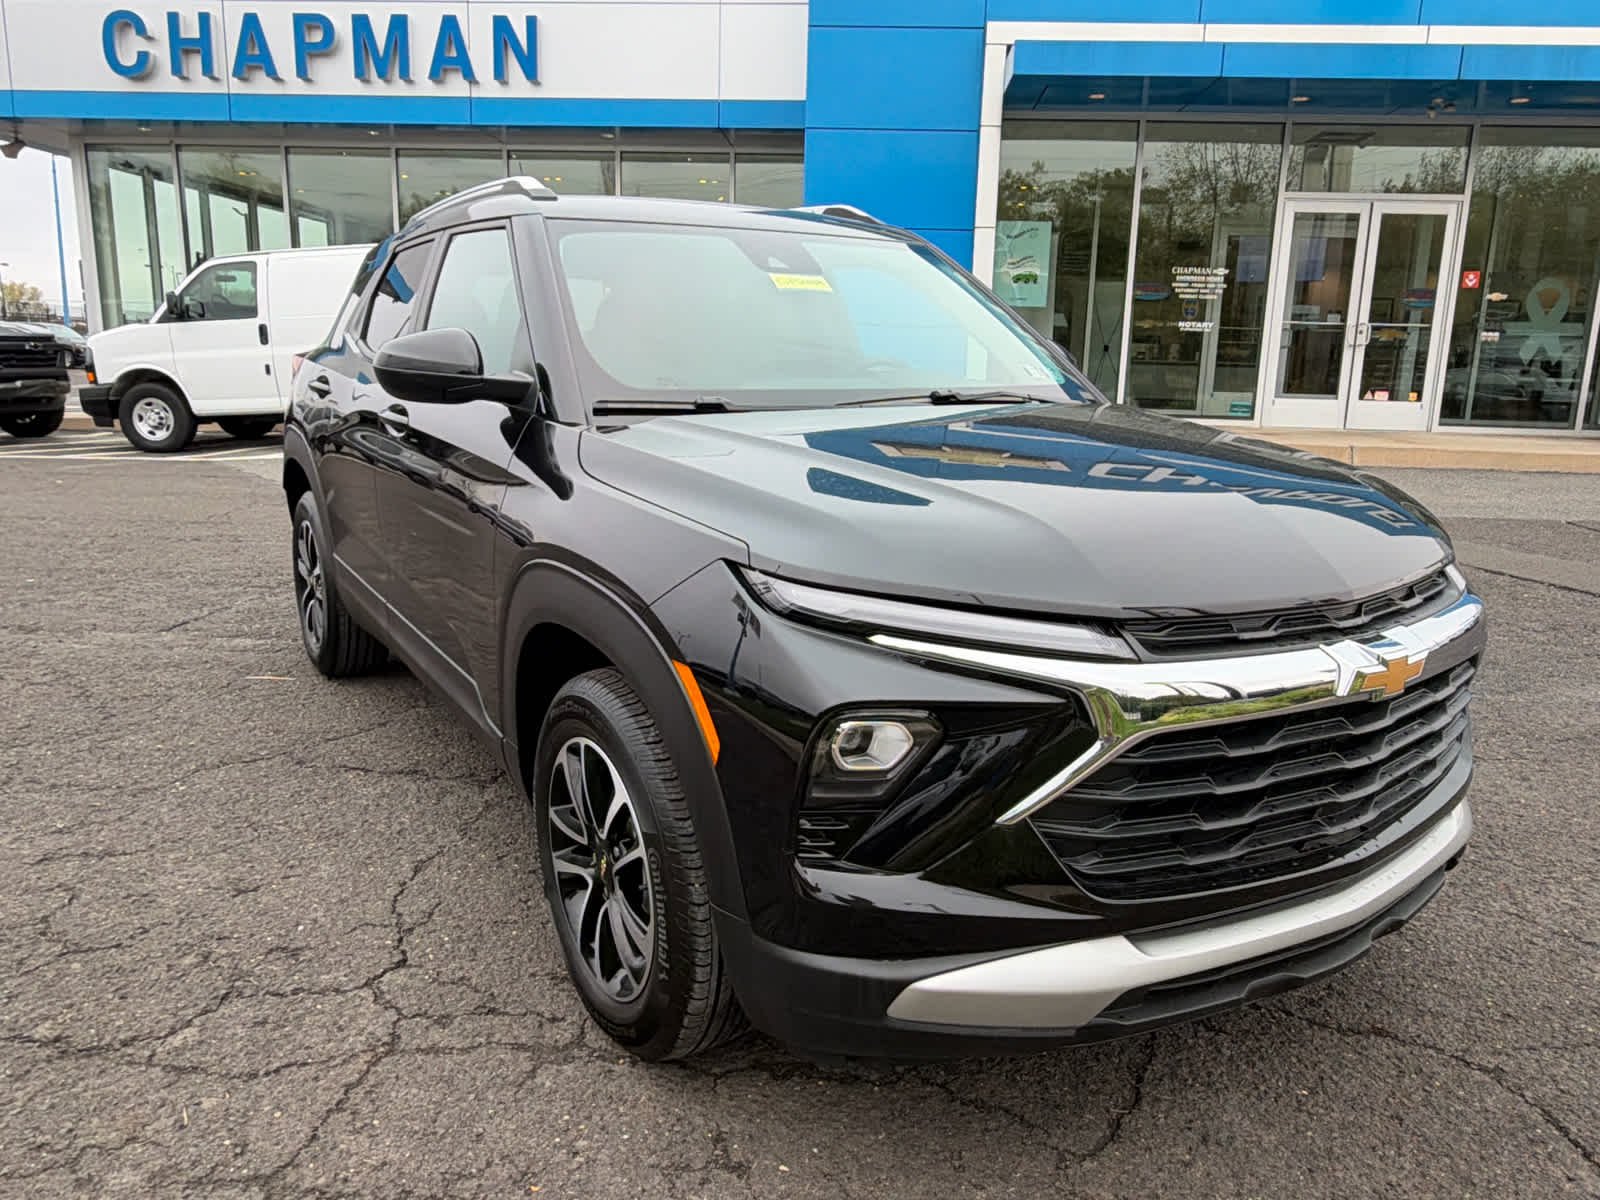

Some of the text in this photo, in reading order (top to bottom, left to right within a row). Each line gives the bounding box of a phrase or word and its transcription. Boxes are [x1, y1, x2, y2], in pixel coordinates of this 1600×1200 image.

[102, 9, 539, 83] CHAPMAN
[1171, 266, 1211, 275] CHAPMAN
[1178, 321, 1214, 329] NOTARY
[648, 847, 670, 969] Continental
